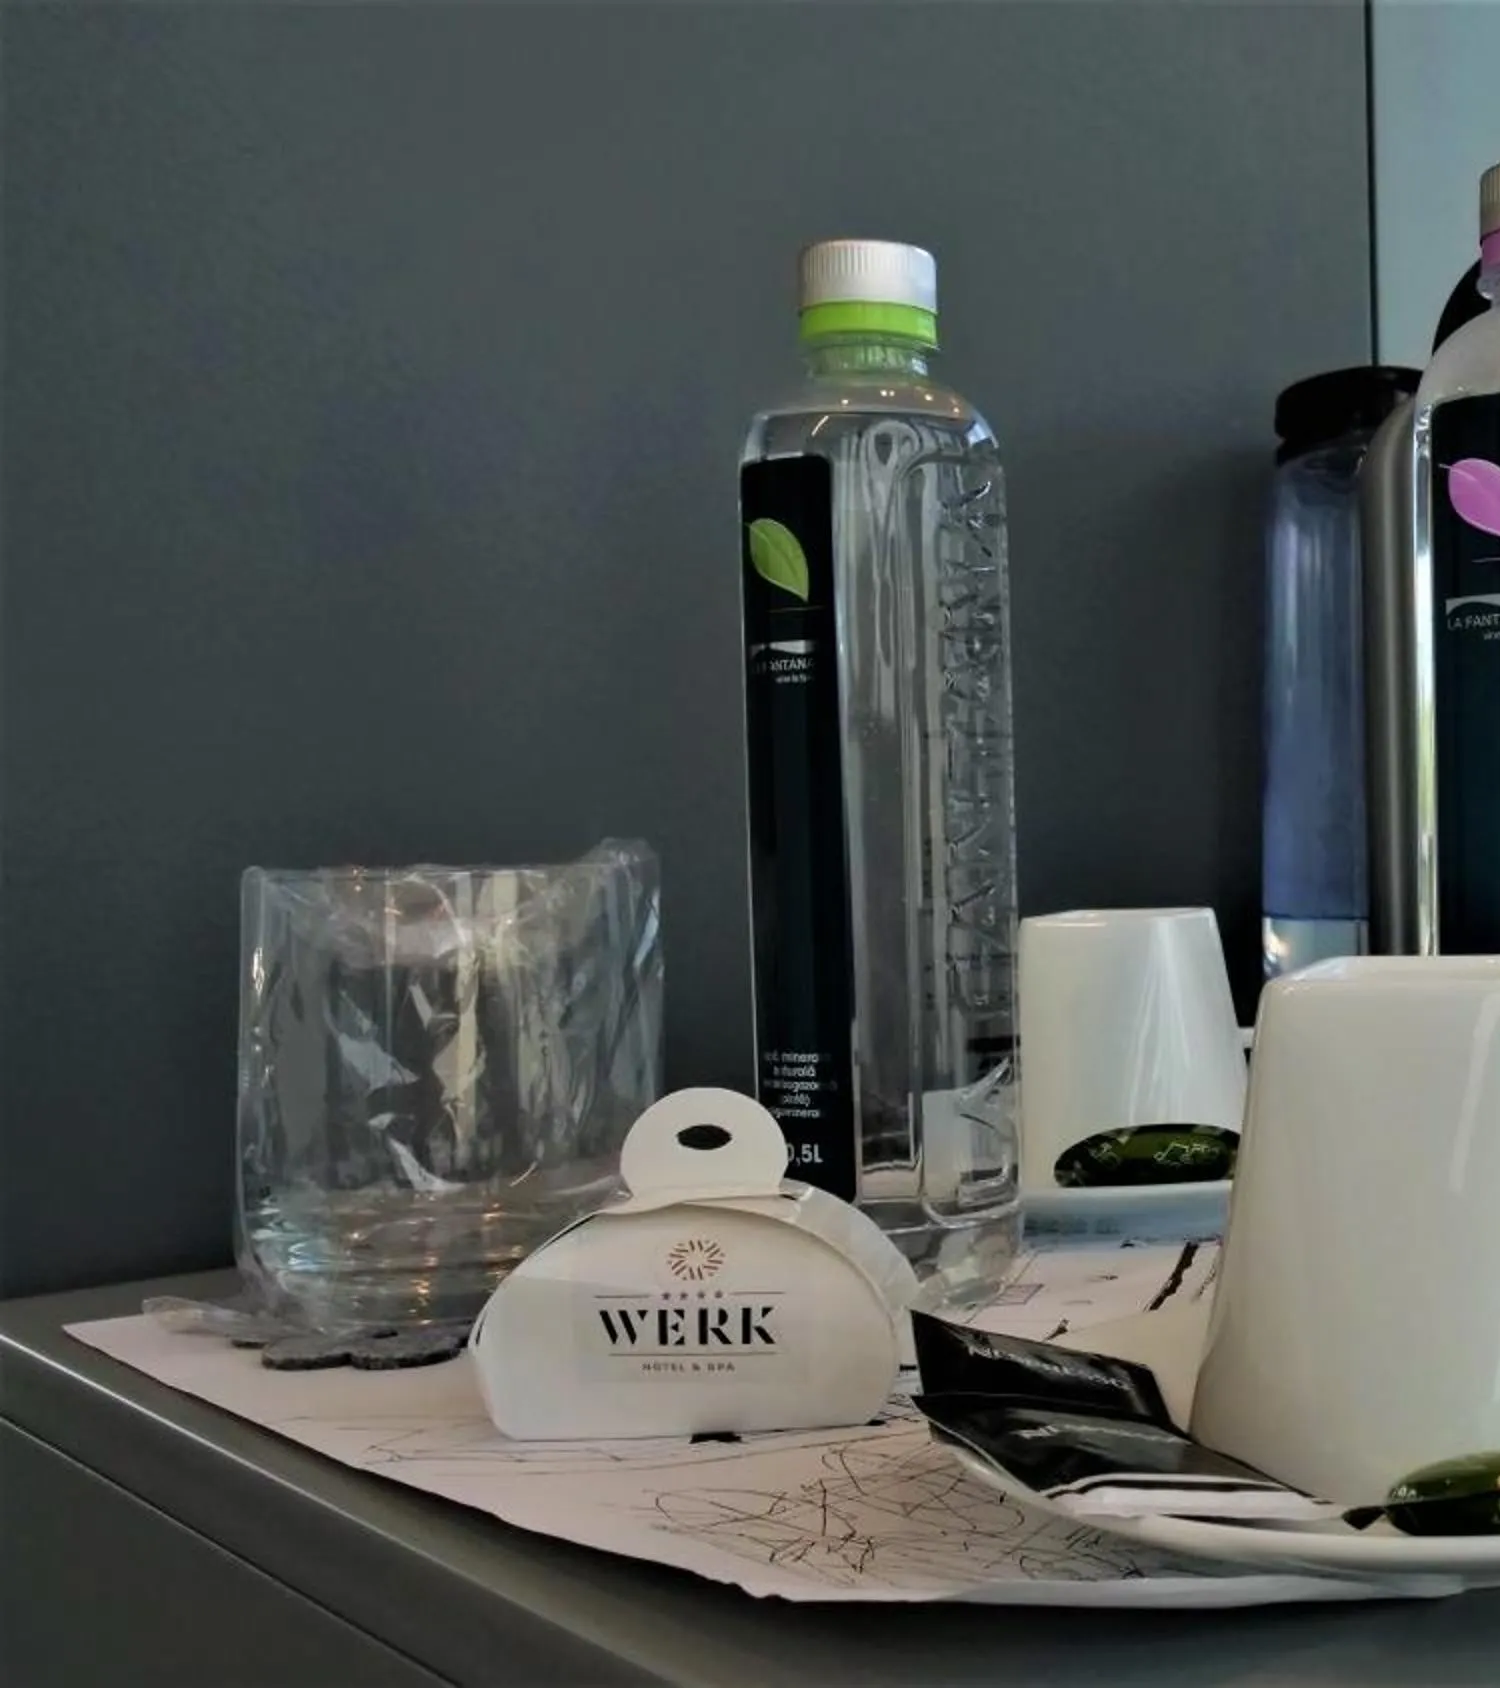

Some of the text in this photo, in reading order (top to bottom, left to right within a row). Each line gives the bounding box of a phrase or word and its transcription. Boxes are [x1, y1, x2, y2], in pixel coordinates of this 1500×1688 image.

[598, 1306, 776, 1346] WERK
[641, 1360, 735, 1373] HOTEL & SPA
